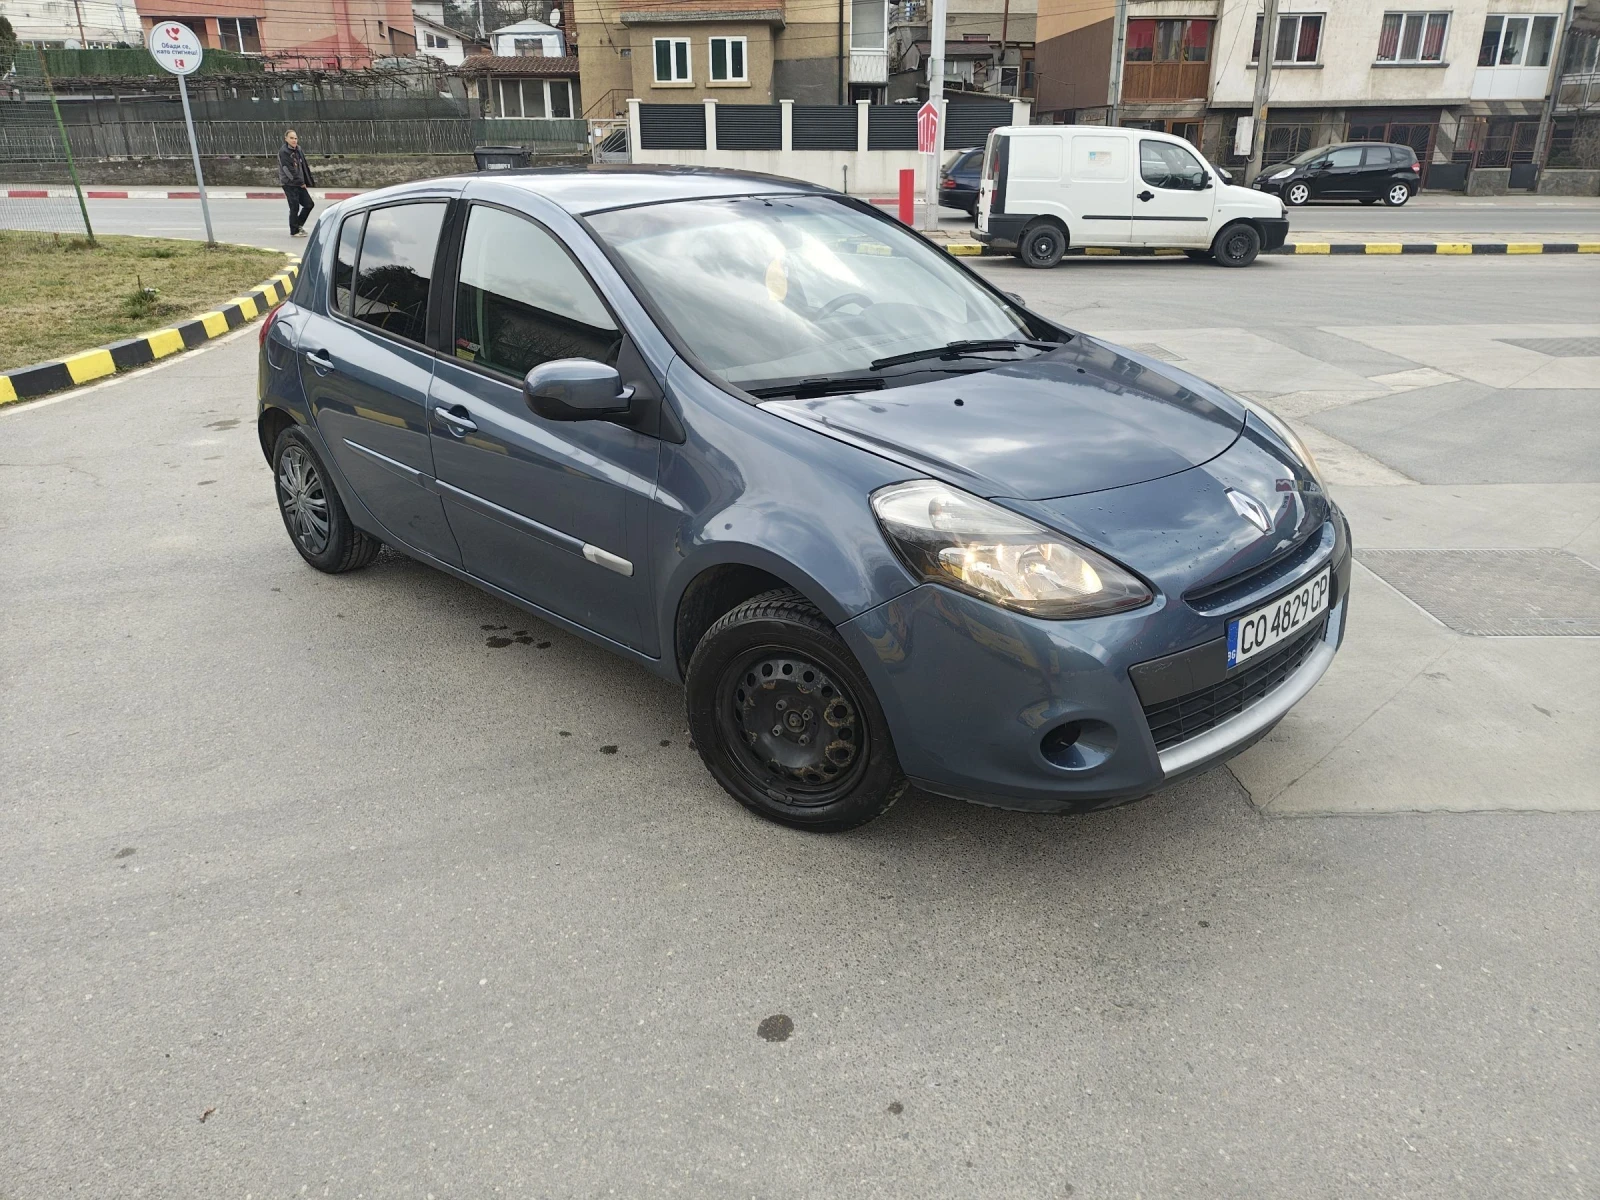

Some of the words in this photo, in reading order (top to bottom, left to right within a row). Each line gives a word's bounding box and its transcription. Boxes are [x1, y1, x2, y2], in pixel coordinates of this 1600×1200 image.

[1242, 614, 1267, 654] CO
[1270, 588, 1309, 637] 4829
[1311, 574, 1328, 612] CP
